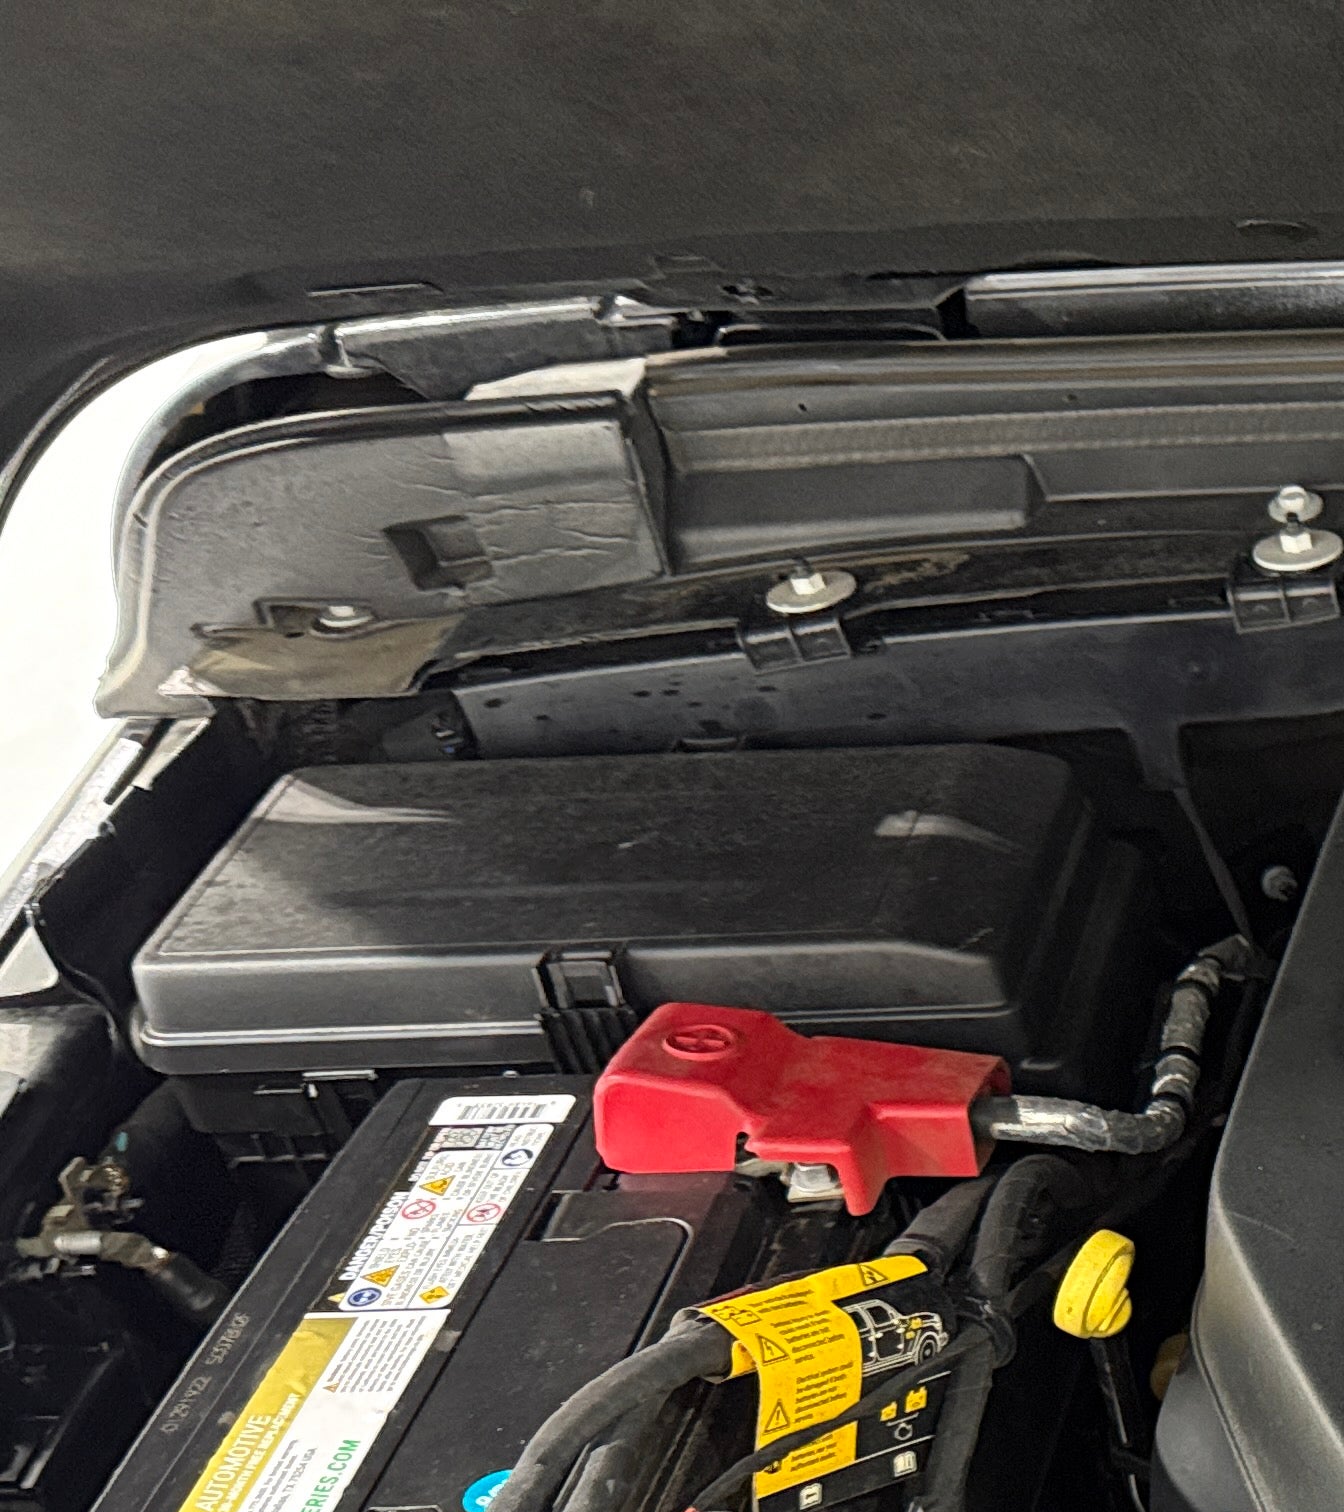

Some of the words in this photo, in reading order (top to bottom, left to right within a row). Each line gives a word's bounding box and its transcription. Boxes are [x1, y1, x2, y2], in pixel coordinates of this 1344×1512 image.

[337, 1190, 410, 1283] DANGER/POISON
[194, 1413, 272, 1512] AUTOMOTIVE
[241, 1448, 268, 1469] FREE
